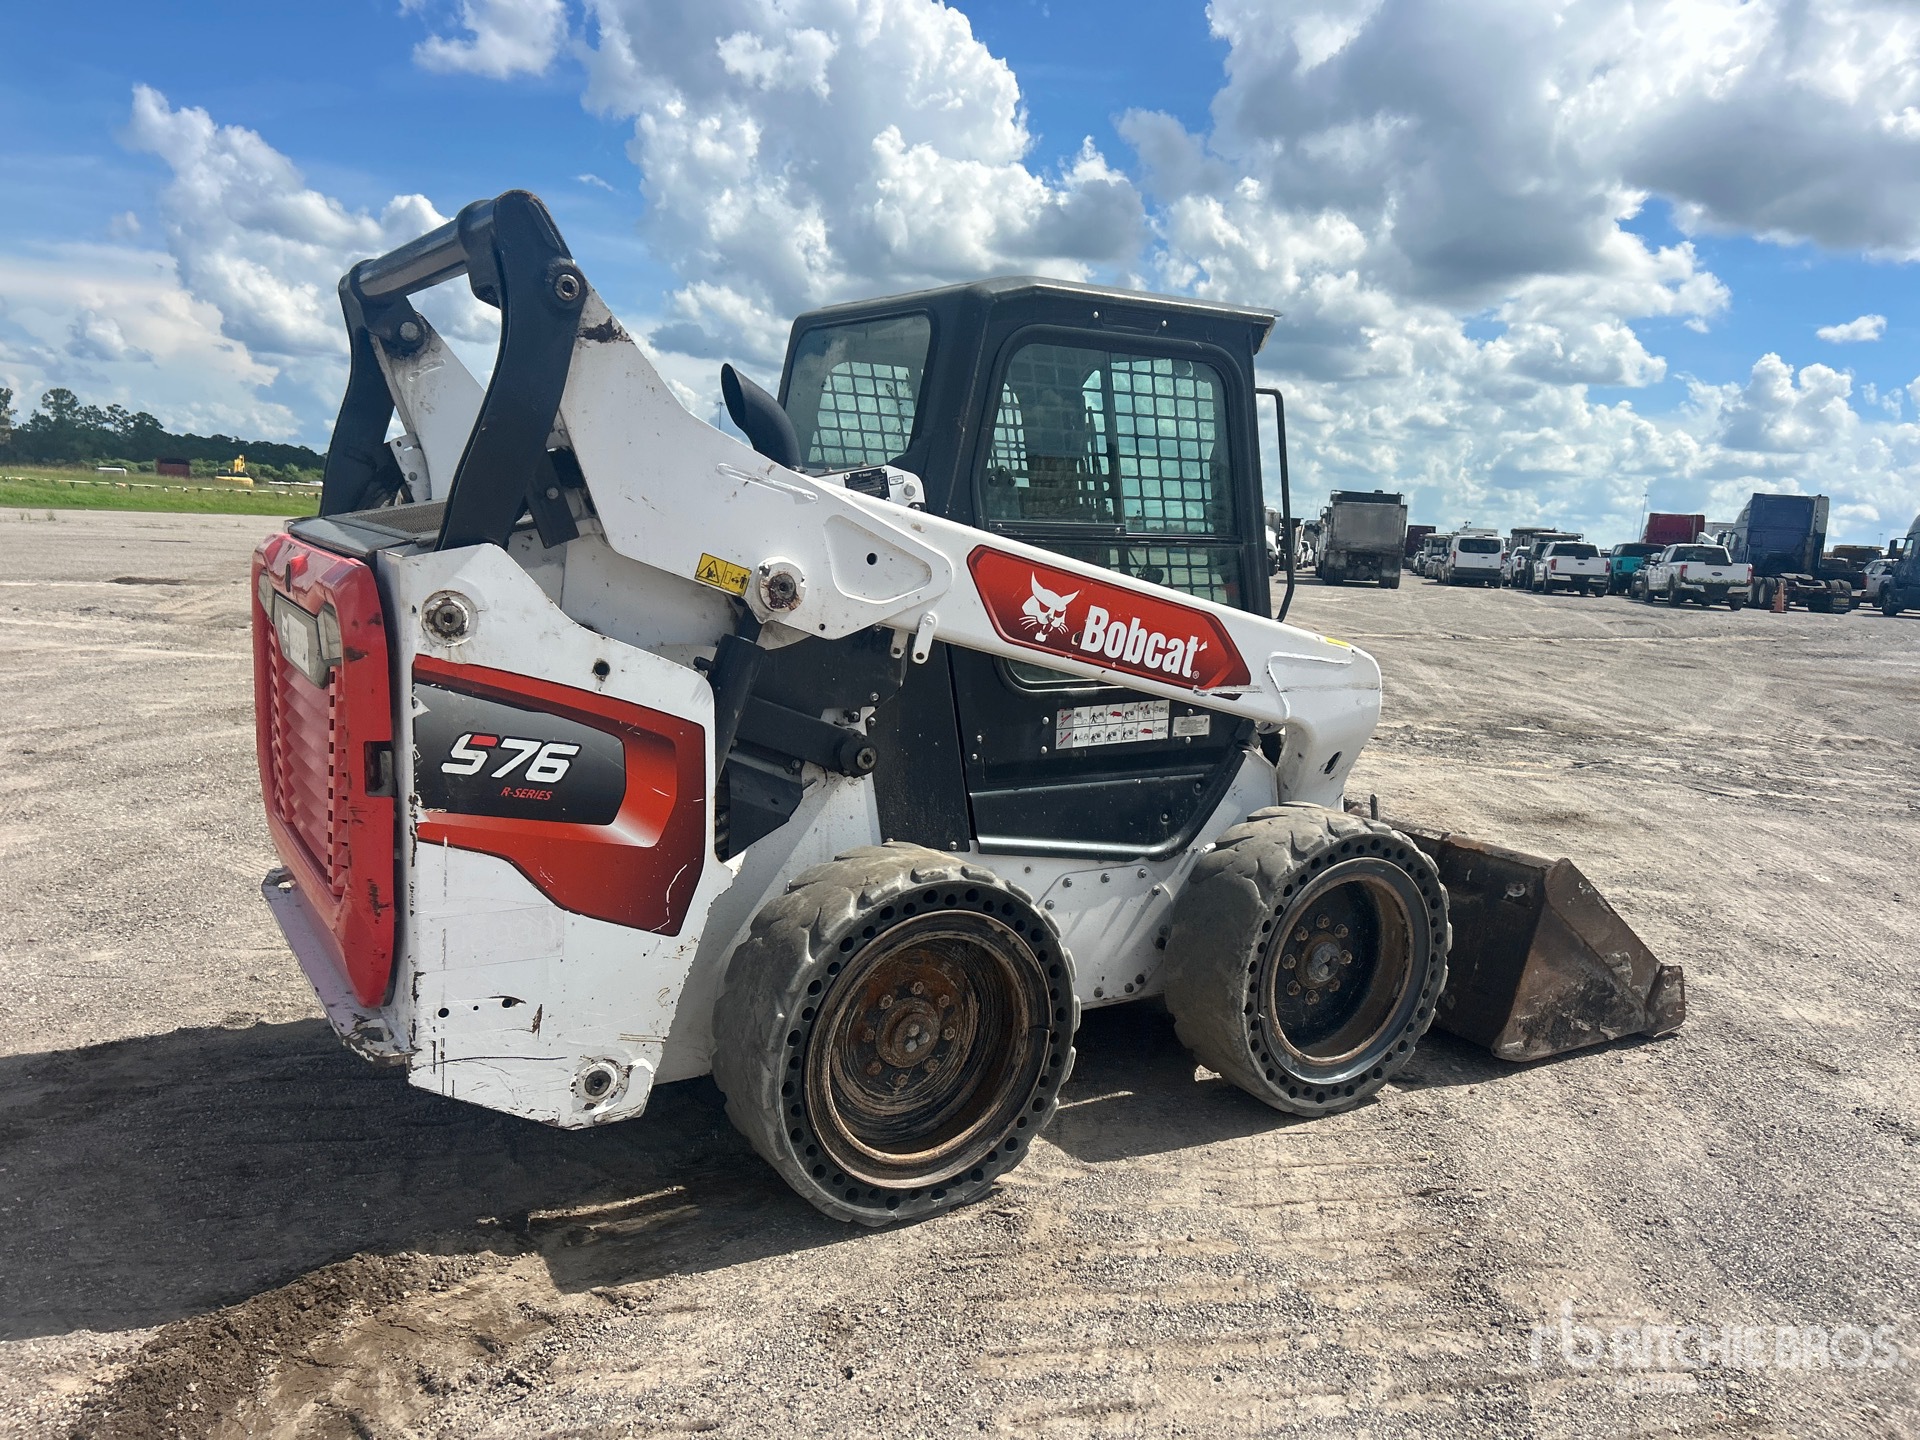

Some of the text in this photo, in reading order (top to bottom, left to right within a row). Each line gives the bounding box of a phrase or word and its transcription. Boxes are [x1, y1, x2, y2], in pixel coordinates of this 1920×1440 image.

[1080, 605, 1199, 678] Bobcat
[441, 733, 580, 783] S76
[501, 786, 553, 800] R-SERIES
